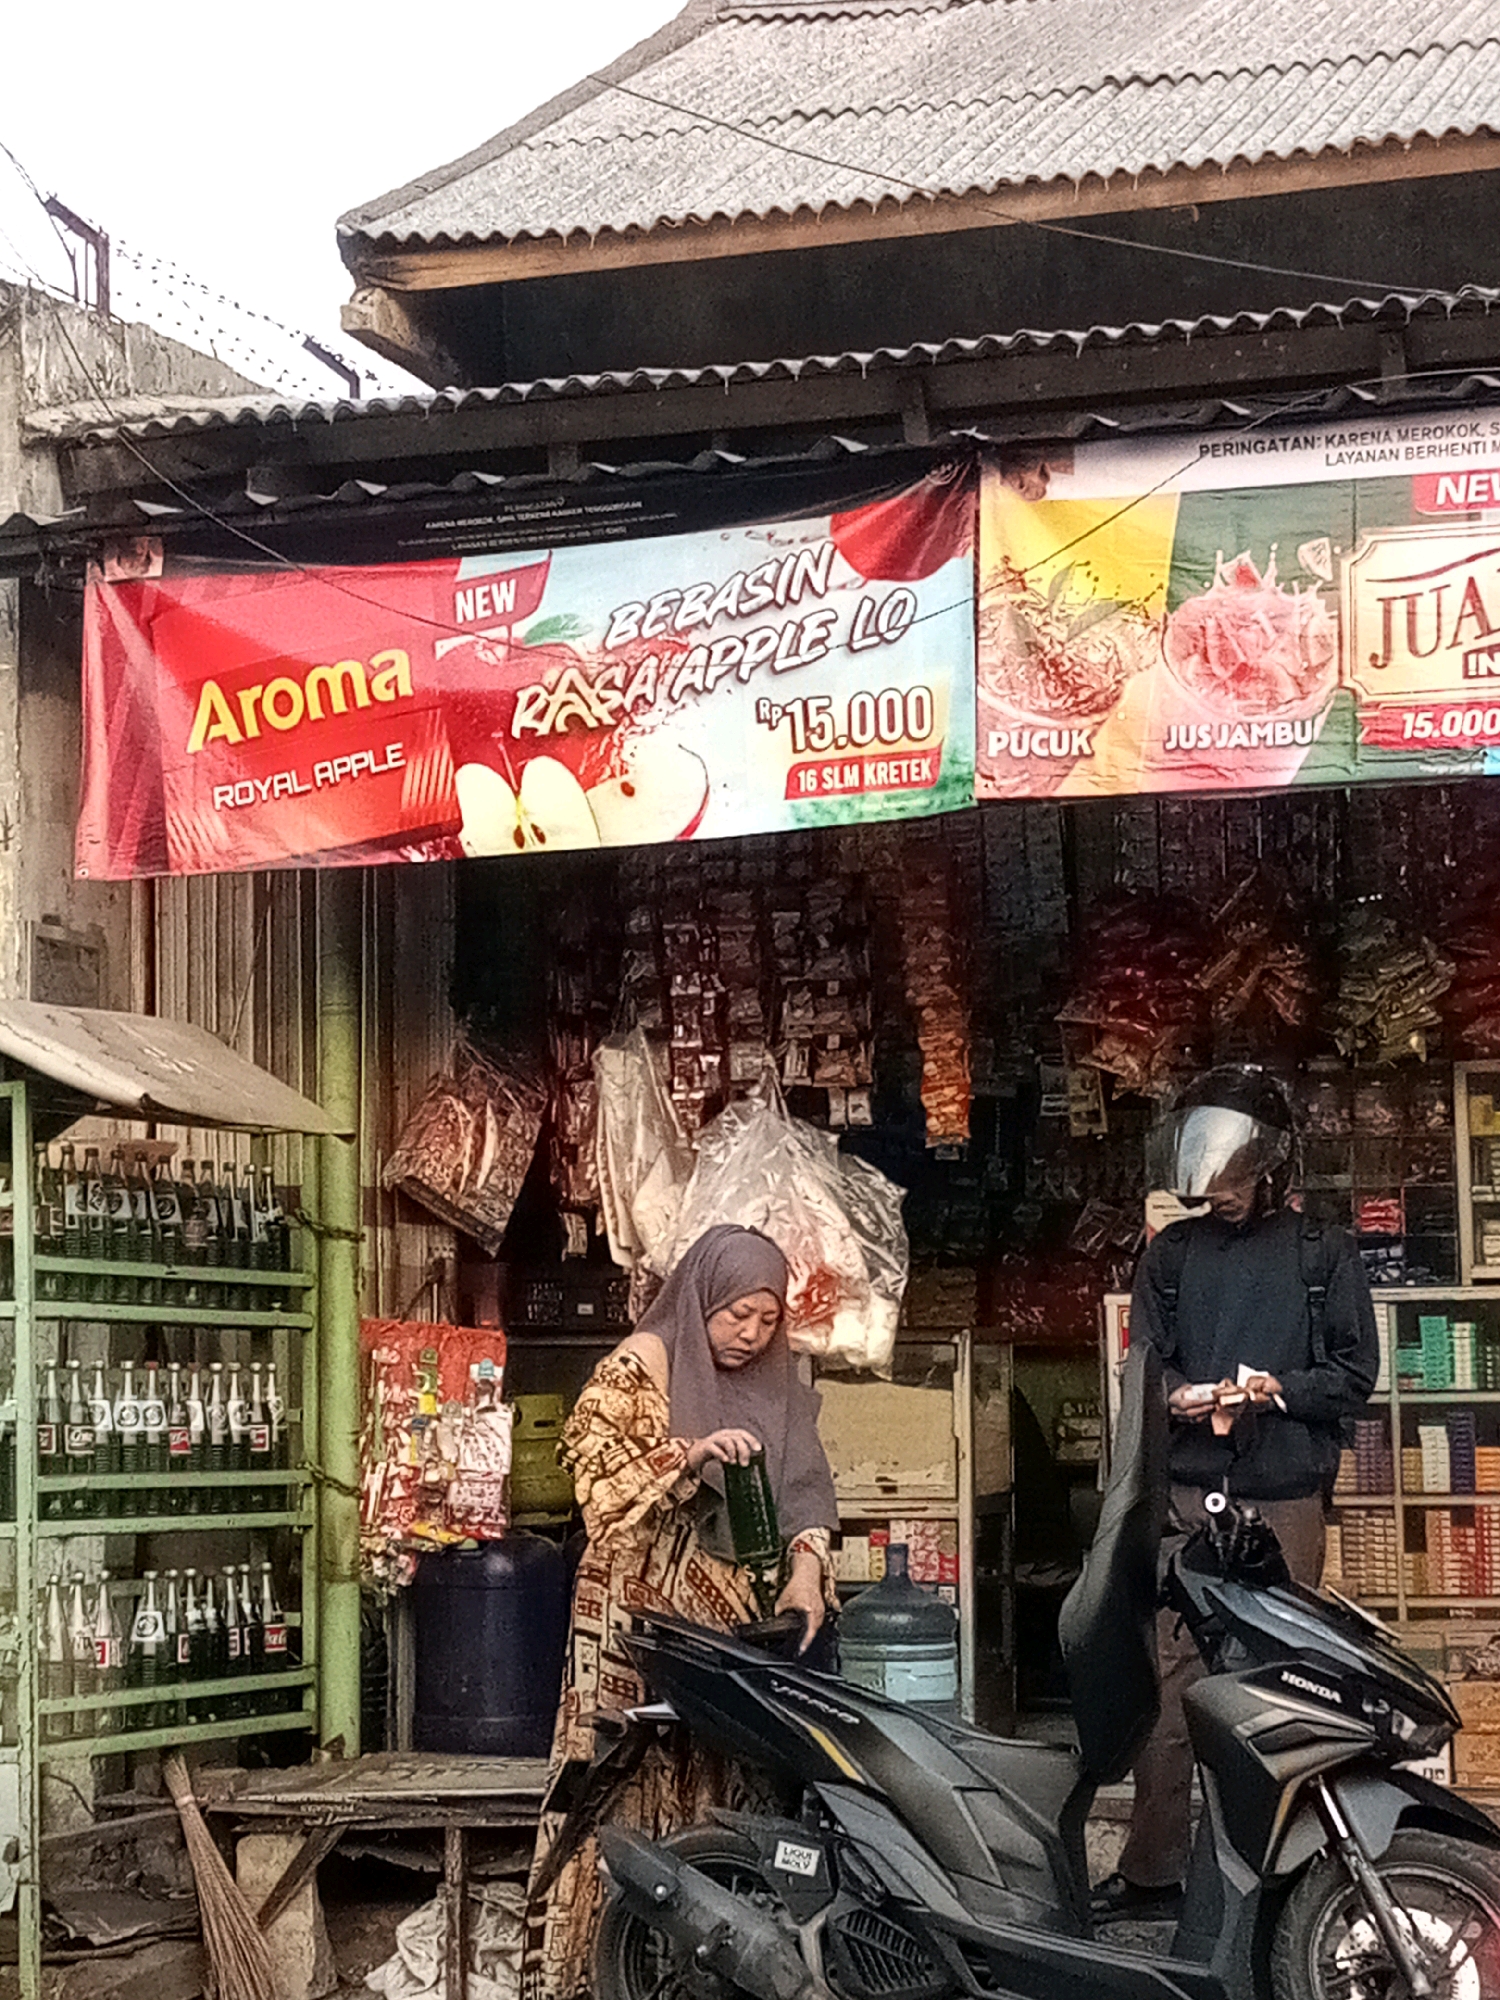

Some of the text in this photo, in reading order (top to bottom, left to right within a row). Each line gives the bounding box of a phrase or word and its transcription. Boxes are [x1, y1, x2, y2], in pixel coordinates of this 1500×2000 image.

[1199, 435, 1322, 458] PERINGATAN:
[1325, 430, 1392, 449] KARENA
[1325, 448, 1399, 466] LAYANAN
[1405, 441, 1486, 460] BERHENTI
[1436, 472, 1500, 506] NE
[455, 578, 516, 624] NEW
[604, 541, 837, 650] BEBASIN
[1368, 568, 1500, 669] JUA
[511, 587, 917, 739] RASA APPLE LO
[186, 649, 413, 754] Aroma
[1164, 718, 1315, 750] JUS JAMBU
[1402, 706, 1500, 739] 15.000
[987, 728, 1096, 758] PUCUK
[213, 742, 406, 811] ROYAL APPLE
[797, 757, 932, 792] 16 SLM KRETEK
[1281, 1670, 1342, 1704] HONDA
